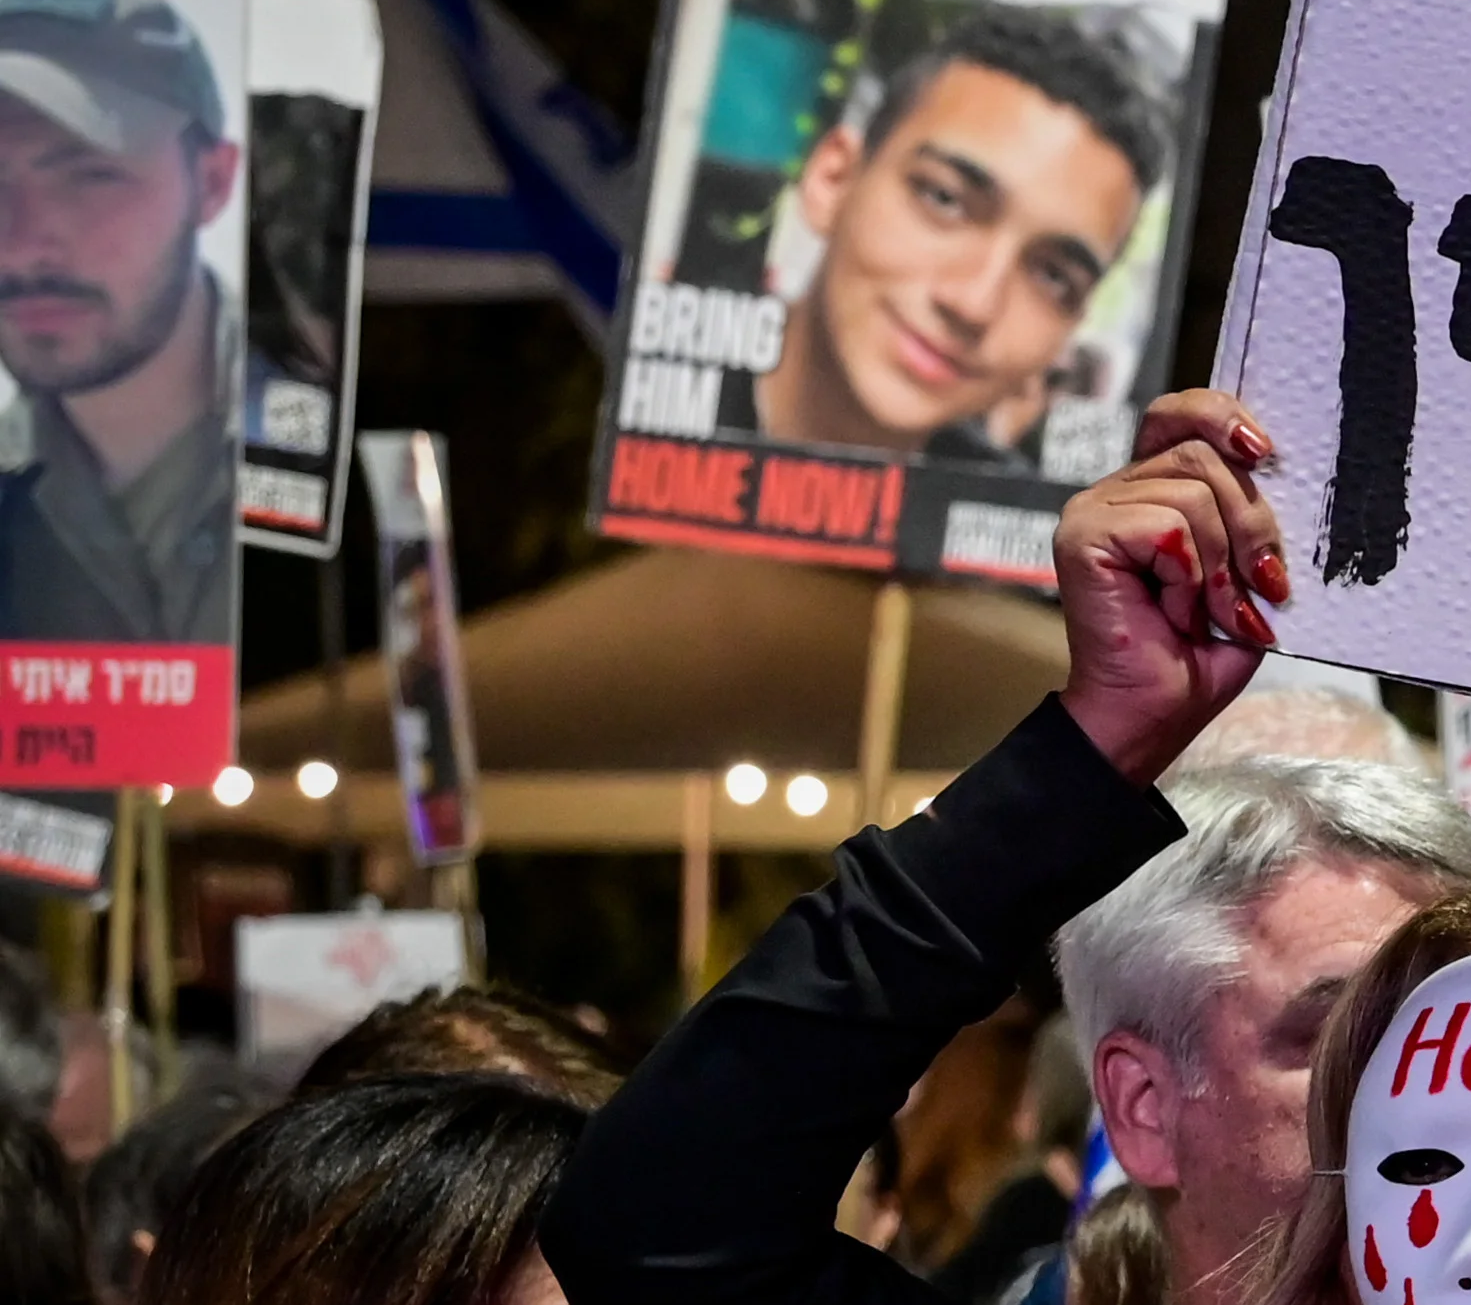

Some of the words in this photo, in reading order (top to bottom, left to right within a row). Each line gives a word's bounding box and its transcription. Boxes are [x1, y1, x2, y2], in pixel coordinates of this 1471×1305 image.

[630, 280, 787, 372] BRING
[618, 355, 722, 438] HIM
[609, 435, 753, 523] HOME
[757, 456, 904, 544] NOW!
[9, 657, 92, 705] איתי
